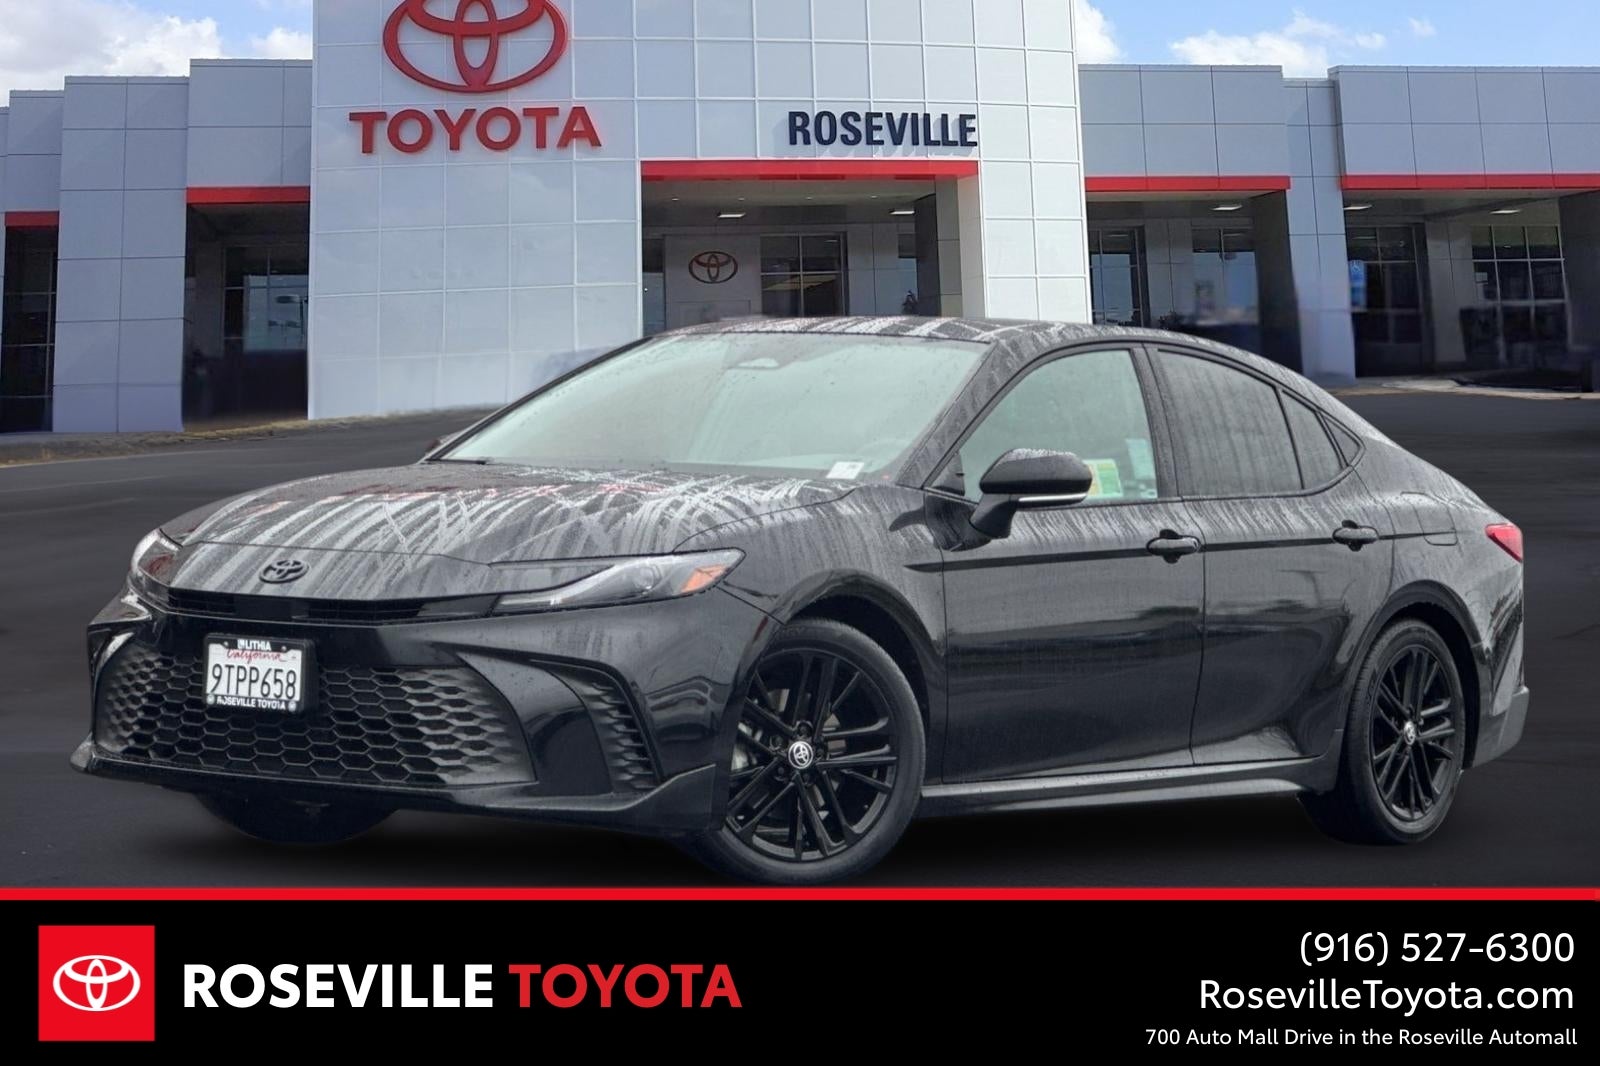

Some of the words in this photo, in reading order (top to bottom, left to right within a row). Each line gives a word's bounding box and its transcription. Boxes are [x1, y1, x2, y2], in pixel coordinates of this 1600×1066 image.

[350, 106, 602, 153] TOYOTA
[788, 110, 978, 147] ROSEVILLE
[226, 649, 287, 664] California
[244, 640, 272, 651] LITHIA
[210, 663, 297, 700] 9TPP658
